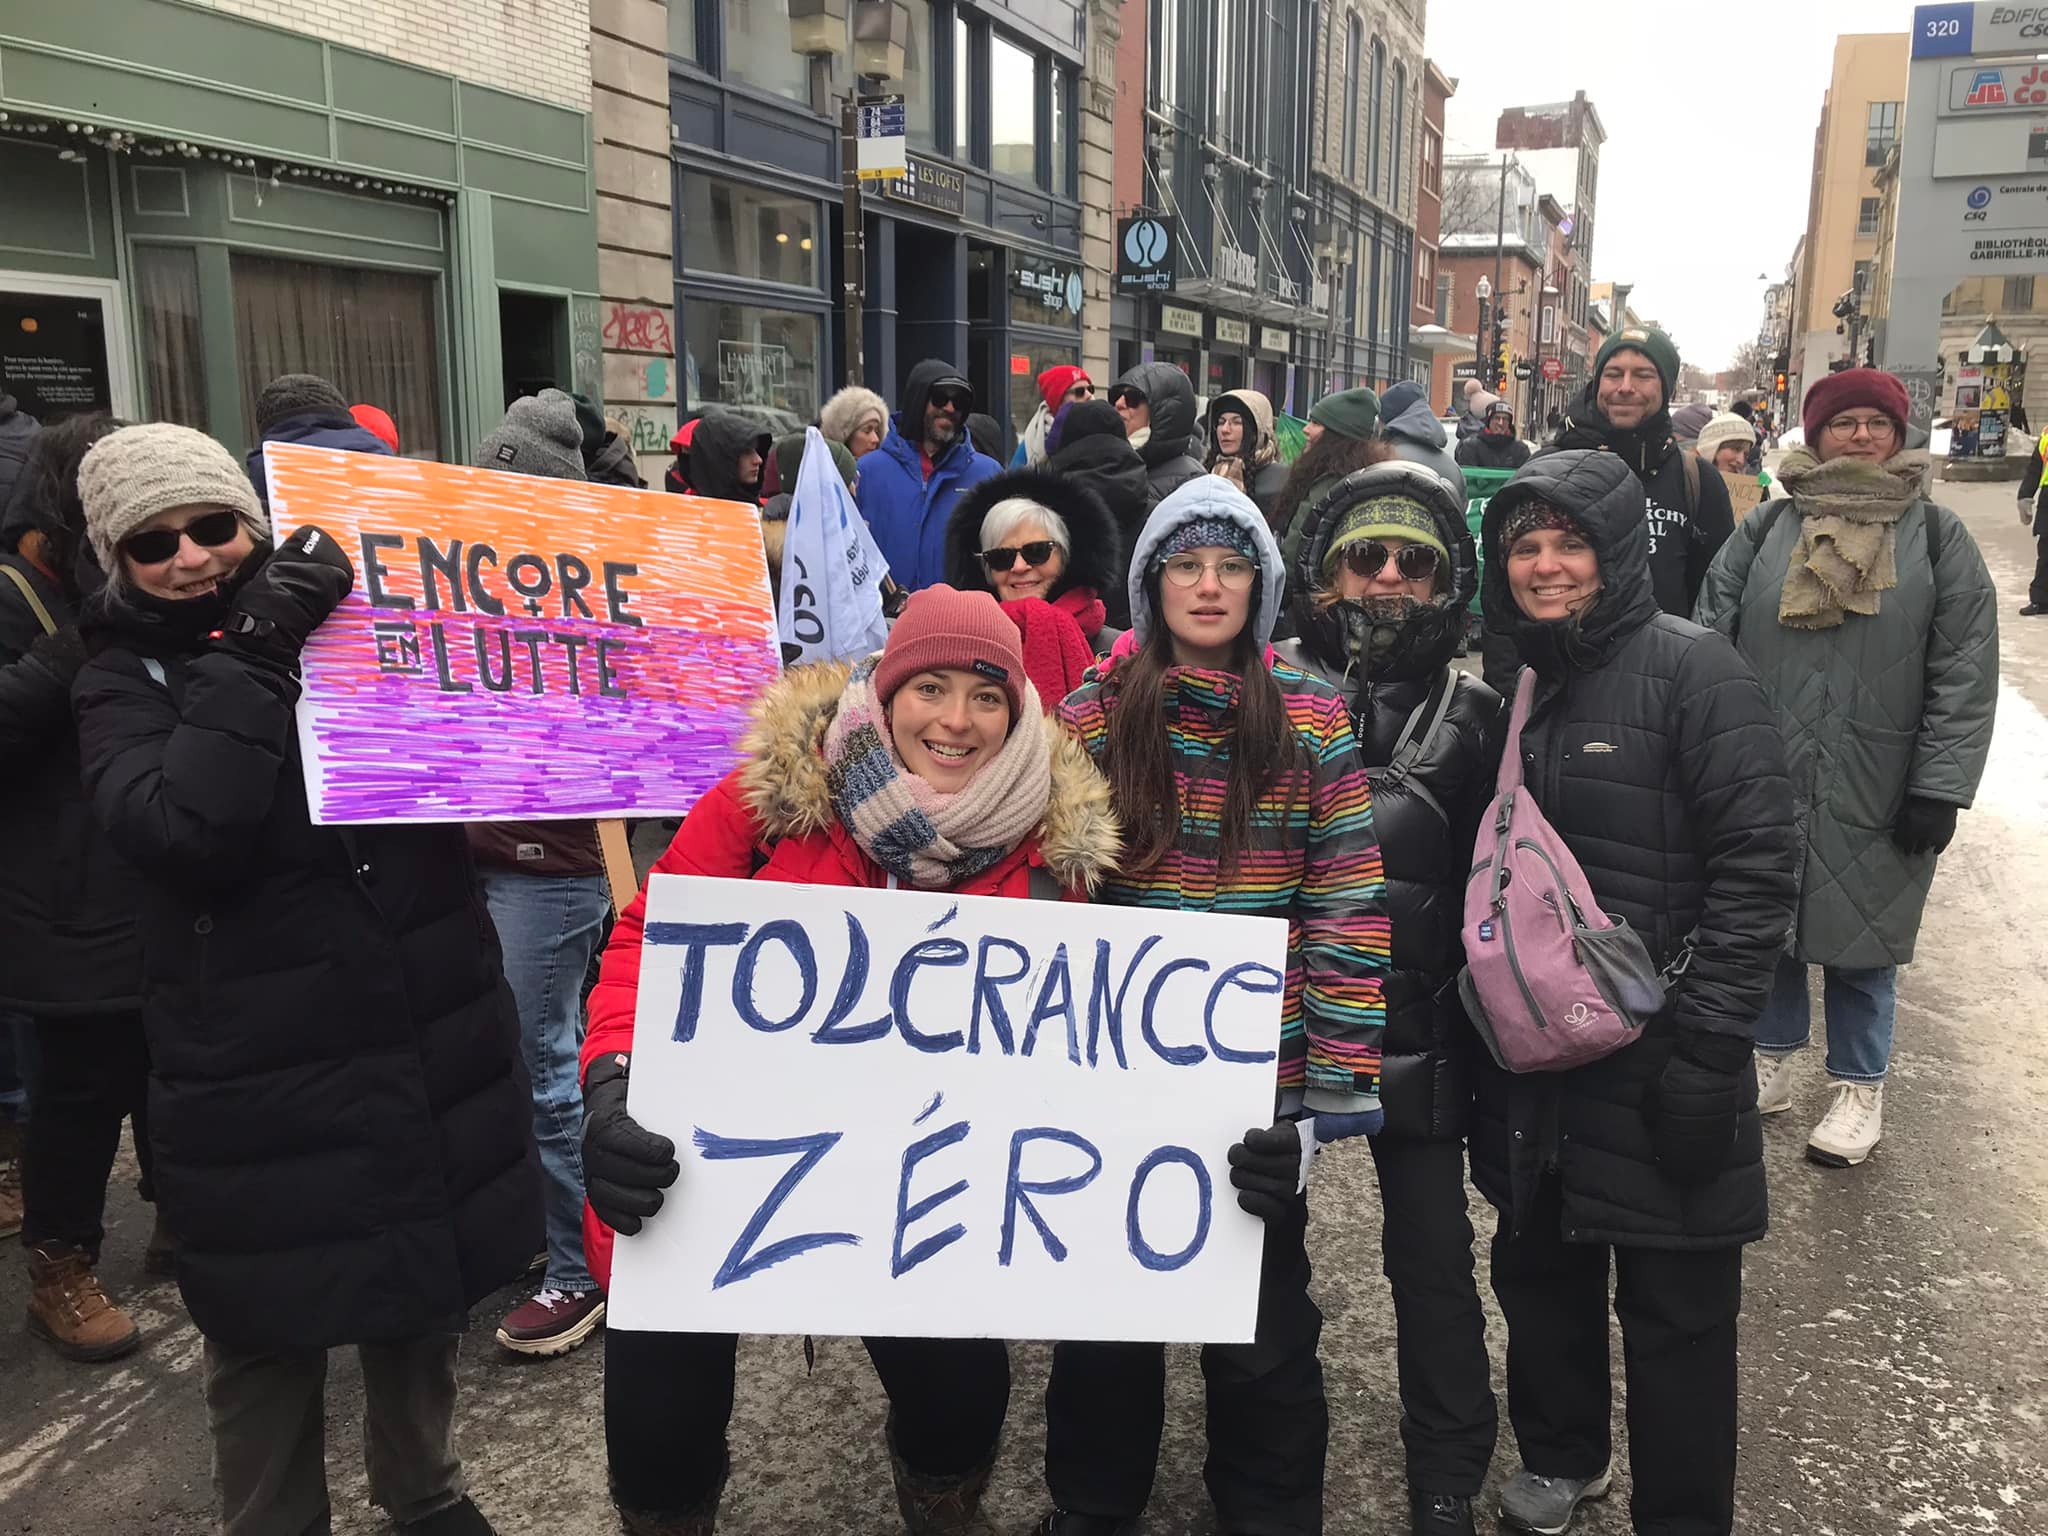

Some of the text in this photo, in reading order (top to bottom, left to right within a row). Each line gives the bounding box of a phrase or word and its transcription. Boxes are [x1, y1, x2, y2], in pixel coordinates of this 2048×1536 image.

[1927, 20, 1960, 37] 320
[919, 166, 935, 184] LES
[936, 172, 960, 192] LOFTS
[1999, 185, 2034, 194] Centrale
[1964, 211, 1988, 222] CSQ
[1970, 249, 2048, 260] GABRIELLE-R
[1020, 267, 1065, 293] sushi
[1121, 270, 1171, 284] sushi
[1147, 281, 1169, 290] shop
[1043, 293, 1063, 310] shop
[360, 533, 643, 627] ENCORE
[430, 622, 628, 698] LUTTE
[692, 1090, 1212, 1291] ZÉRO
